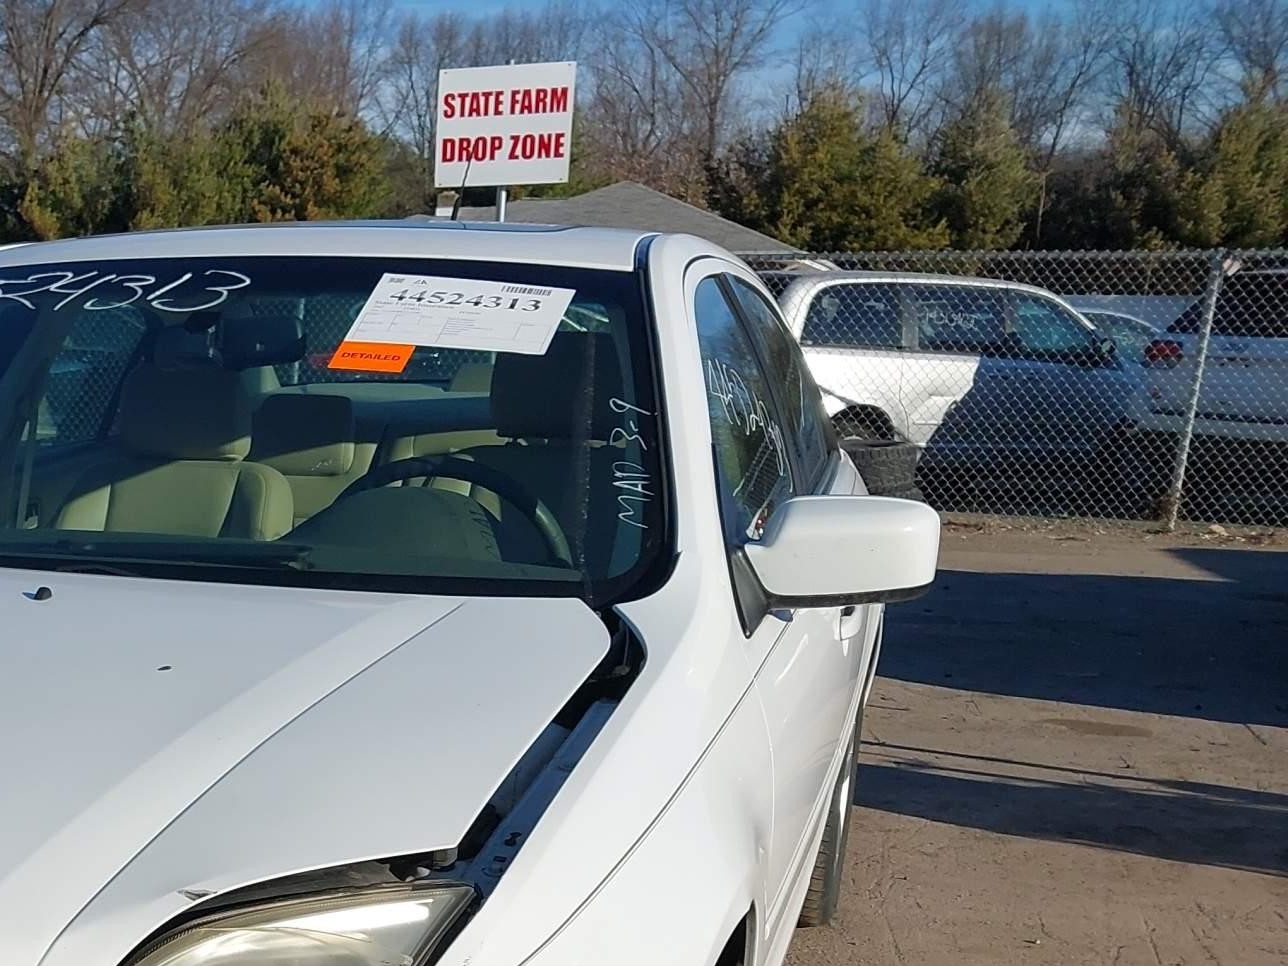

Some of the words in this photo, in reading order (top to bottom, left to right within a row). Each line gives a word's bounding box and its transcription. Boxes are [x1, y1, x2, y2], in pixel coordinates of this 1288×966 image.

[443, 90, 504, 119] STATE
[509, 86, 569, 115] FARM
[441, 136, 503, 163] DROP
[508, 133, 565, 161] ZONE
[389, 288, 542, 313] 44524313
[340, 351, 402, 362] DETAILED
